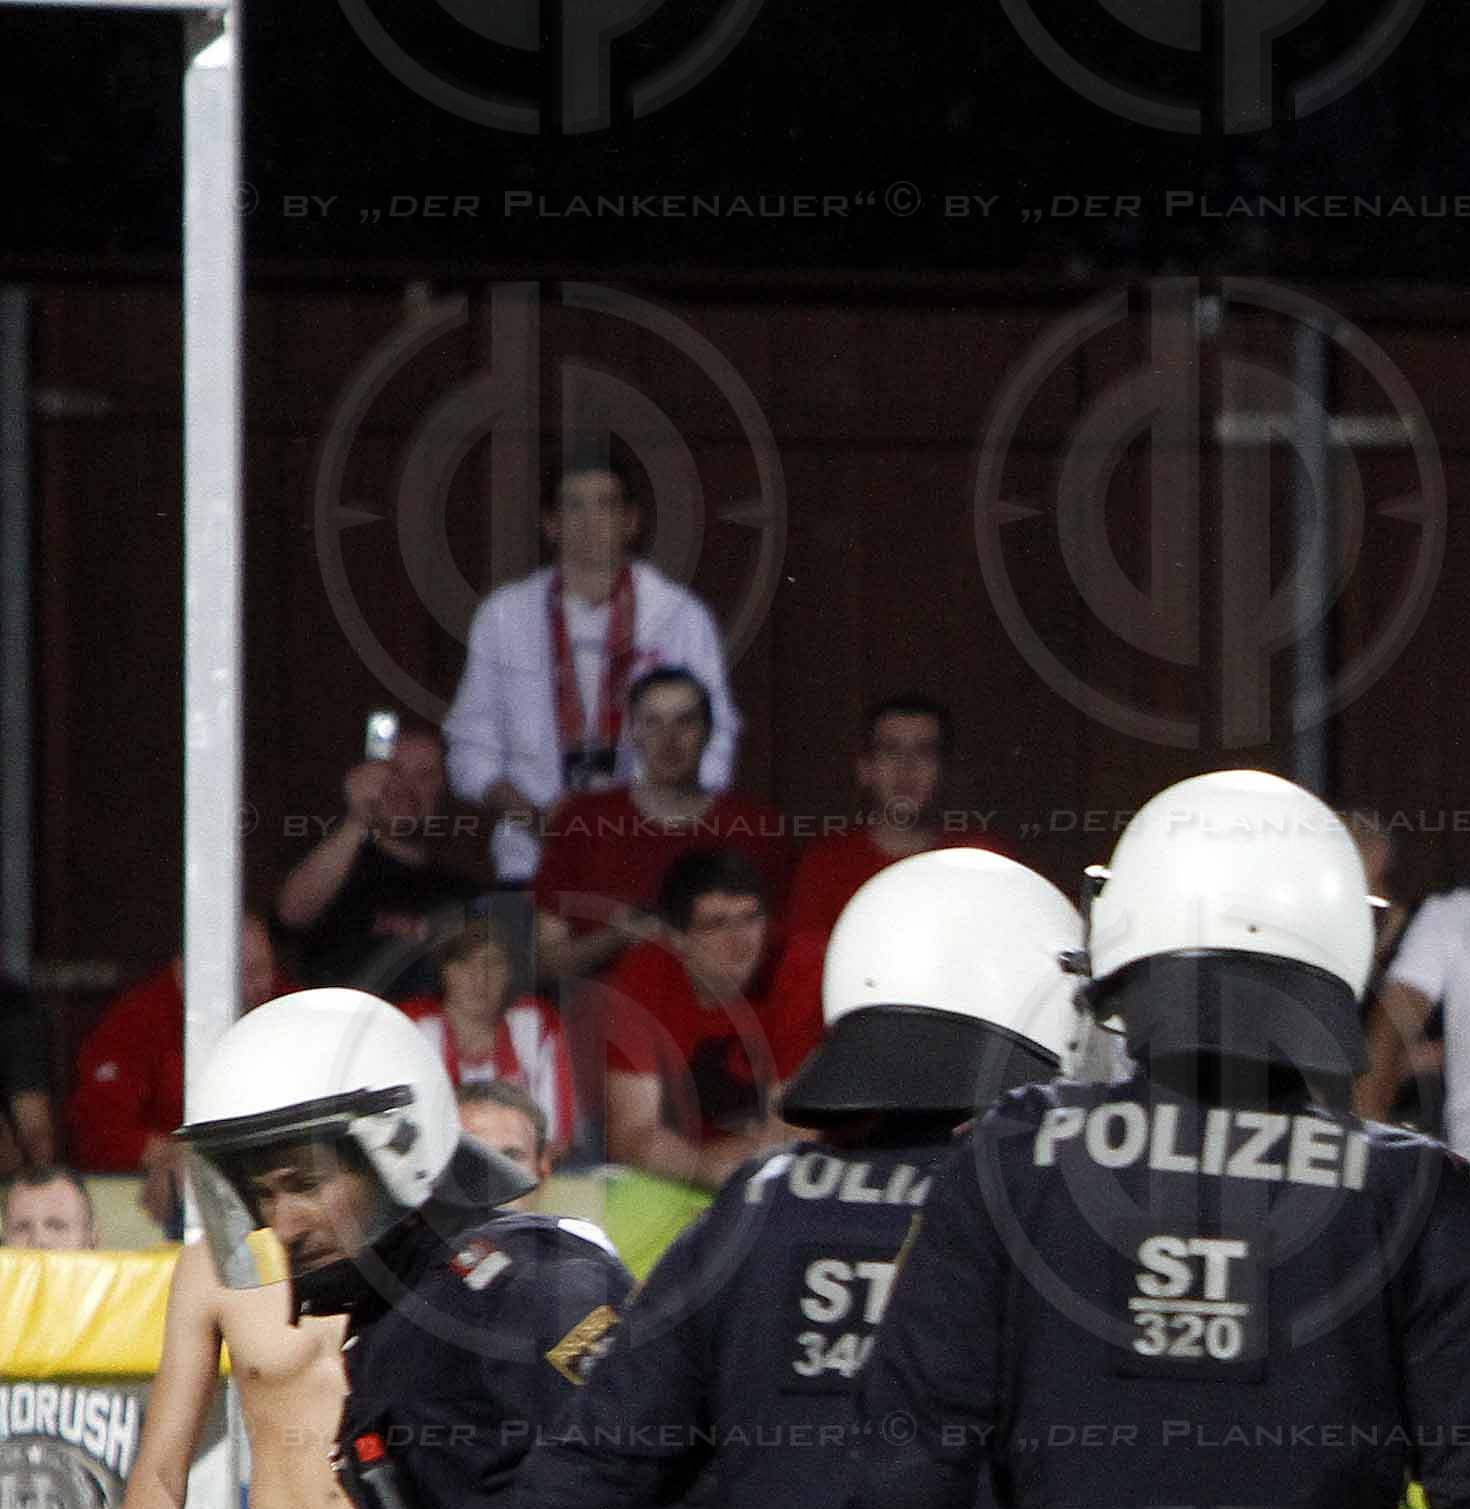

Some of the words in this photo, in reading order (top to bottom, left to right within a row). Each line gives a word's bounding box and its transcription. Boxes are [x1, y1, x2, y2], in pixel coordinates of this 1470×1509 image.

[1032, 1101, 1370, 1190] POLIZEI
[745, 1152, 932, 1207] POLI
[800, 1258, 897, 1325] ST
[1135, 1235, 1248, 1301] ST
[1132, 1311, 1243, 1361] 320
